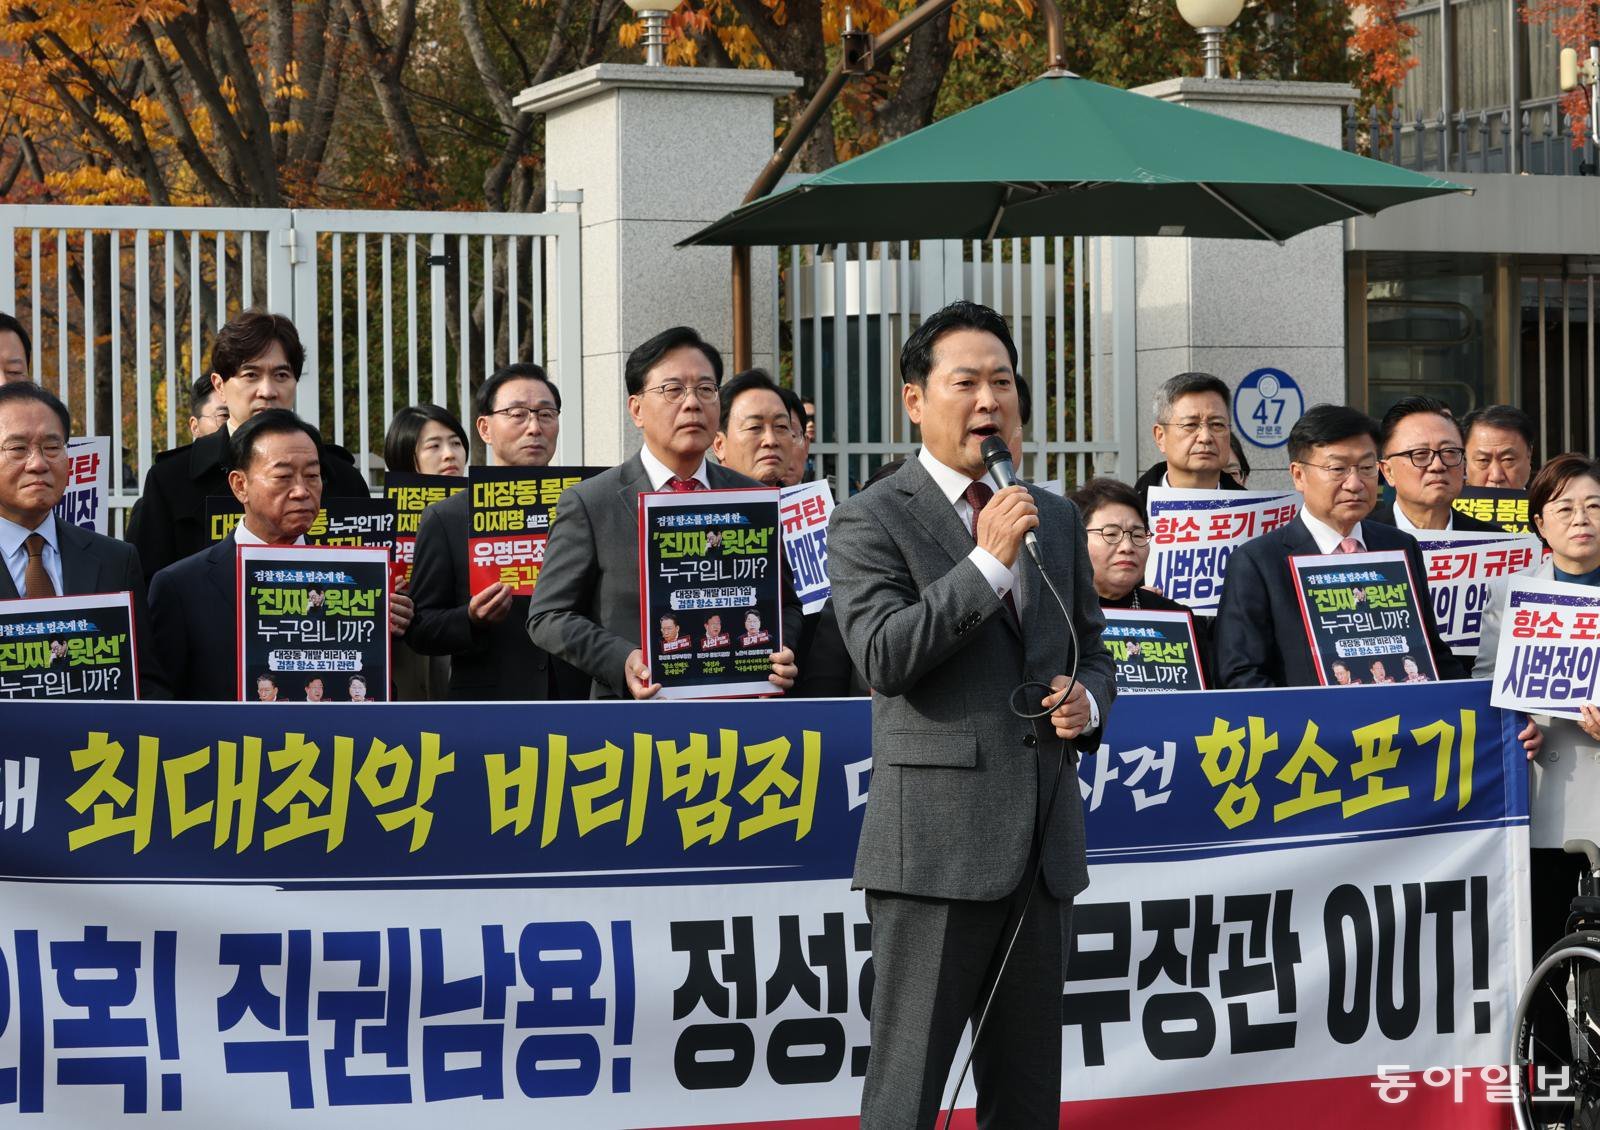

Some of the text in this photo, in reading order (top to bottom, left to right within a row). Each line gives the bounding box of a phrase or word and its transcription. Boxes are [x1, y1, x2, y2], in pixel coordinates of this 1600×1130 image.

[1252, 399, 1285, 424] 47
[474, 480, 538, 507] 대장동
[329, 514, 394, 534] 누구인가?
[474, 510, 525, 532] 이재명
[527, 515, 548, 528] 셀프
[676, 514, 703, 526] 항소를
[731, 512, 741, 524] 한
[780, 495, 827, 534] 규탄
[1155, 517, 1200, 544] 항소
[1208, 511, 1256, 541] 포기
[254, 571, 346, 582] 검찰 항소를 멈추게 한
[659, 557, 768, 583] 누구입니까?
[1427, 548, 1532, 581] 포기 규탄
[675, 589, 701, 599] 대장동
[703, 588, 719, 598] 개발
[721, 587, 738, 597] 비리
[678, 596, 750, 609] 검찰 항소 포기 관련
[15, 622, 45, 635] 항소를
[47, 620, 76, 634] 멈추게
[78, 619, 88, 631] 한
[258, 620, 375, 642] 누구입니까?
[1320, 610, 1410, 634] 누구입니까?
[1513, 610, 1600, 640] 항소 포
[1339, 638, 1361, 648] 대장동
[1377, 636, 1390, 645] 비리
[274, 650, 301, 660] 대장동
[304, 650, 321, 660] 개발
[324, 650, 342, 660] 비리
[276, 660, 355, 670] 검찰 항소 포기 관련
[0, 667, 121, 699] 누구입니까?
[1502, 645, 1600, 700] 사법정의
[65, 731, 455, 855] 최대최악
[484, 728, 821, 850] 비리범죄
[1195, 708, 1476, 830] 항소포기
[217, 920, 635, 1109] 직권남용!
[670, 912, 874, 1090] 정성
[1324, 876, 1490, 1044] OUT!
